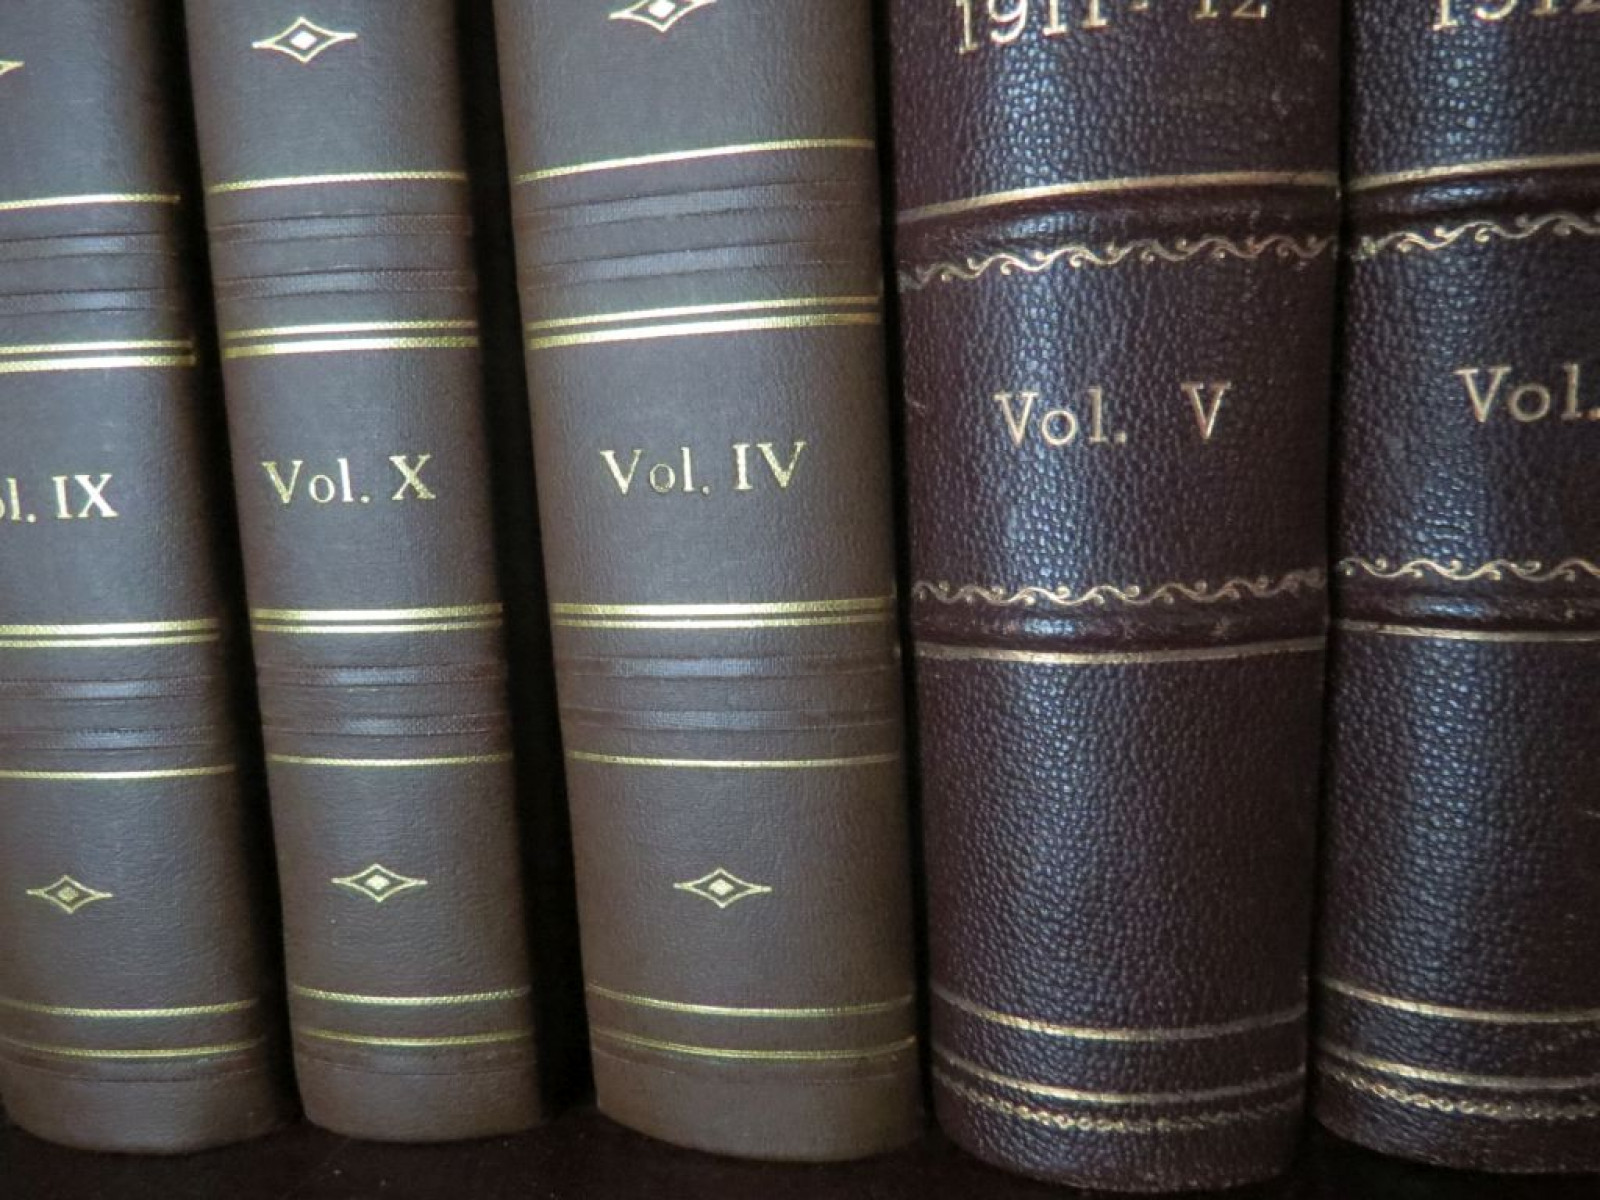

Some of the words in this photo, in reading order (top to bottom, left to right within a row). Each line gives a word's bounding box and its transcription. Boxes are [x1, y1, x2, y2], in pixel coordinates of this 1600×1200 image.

[993, 385, 1127, 448] Vol.
[1180, 380, 1232, 440] V
[1452, 361, 1600, 423] Vol.
[262, 457, 370, 504] Vol.
[389, 453, 436, 500] X
[600, 446, 710, 496] Vol.
[732, 441, 806, 490] IV
[0, 477, 37, 523] l.
[52, 472, 119, 519] IX
